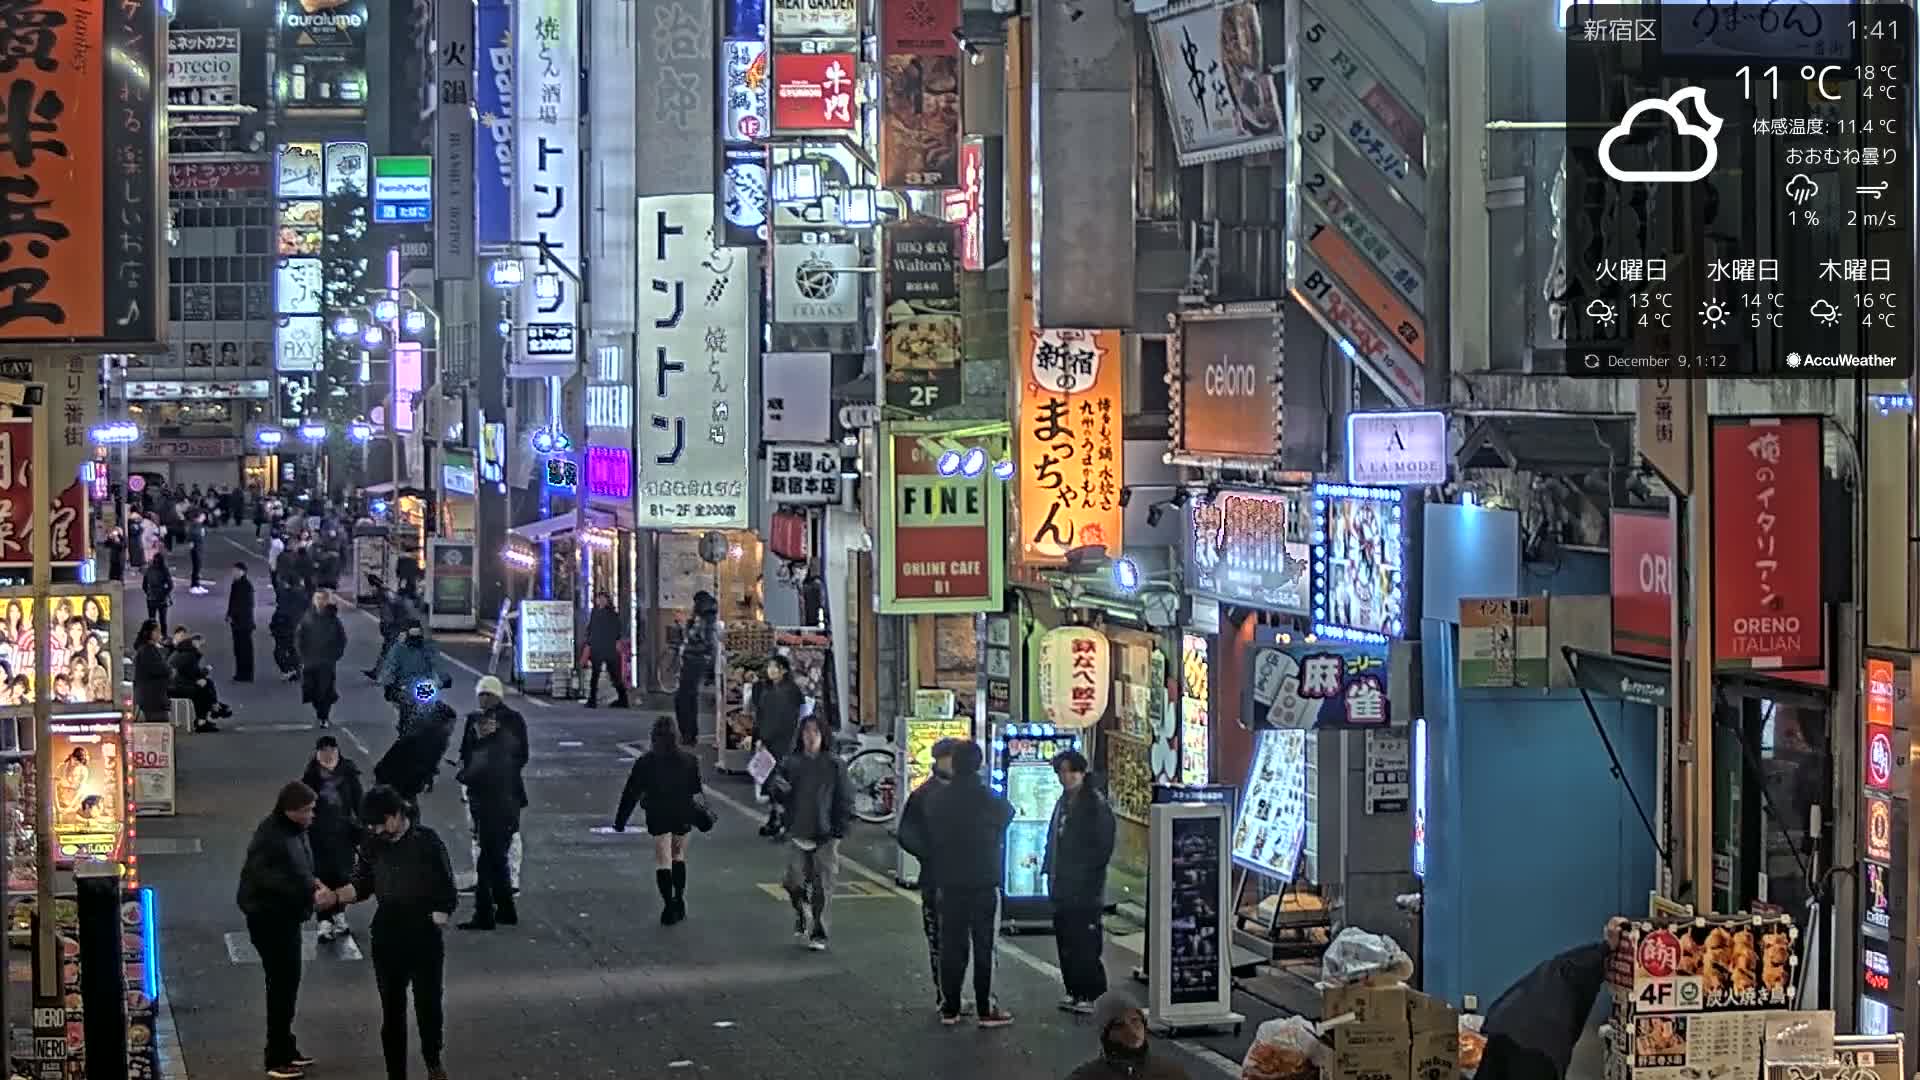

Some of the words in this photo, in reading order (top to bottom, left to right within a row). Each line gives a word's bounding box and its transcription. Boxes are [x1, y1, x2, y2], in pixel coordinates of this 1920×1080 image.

[288, 14, 361, 27] auralume
[1306, 23, 1326, 43] 5
[443, 41, 466, 104] 火鍋
[823, 60, 852, 122] 牛門
[1307, 76, 1324, 92] 4
[1306, 123, 1325, 143] 3
[168, 176, 219, 188] ンバーグ
[1305, 174, 1325, 195] 2
[1309, 223, 1326, 241] 1
[1304, 270, 1331, 299] B1
[651, 211, 685, 464] トントン
[1205, 355, 1256, 396] celona
[909, 387, 938, 407] 2F
[772, 451, 836, 473] 酒場心
[1033, 397, 1078, 547] まっちゃん
[771, 476, 836, 495] 新宿本店
[903, 486, 979, 515] FINE
[1747, 431, 1782, 605] 俺のイタリアン
[903, 562, 946, 576] ONLINE
[951, 561, 981, 575] CAFE
[1733, 617, 1800, 634] ORENO
[1732, 634, 1801, 653] ITALIAN
[1303, 655, 1387, 721] 麻雀
[131, 751, 169, 768] 80円
[1640, 983, 1673, 1005] 4F
[1706, 984, 1787, 1008] 炭火焼き鳥
[34, 1007, 65, 1028] NERO
[37, 1040, 66, 1057] NERO
